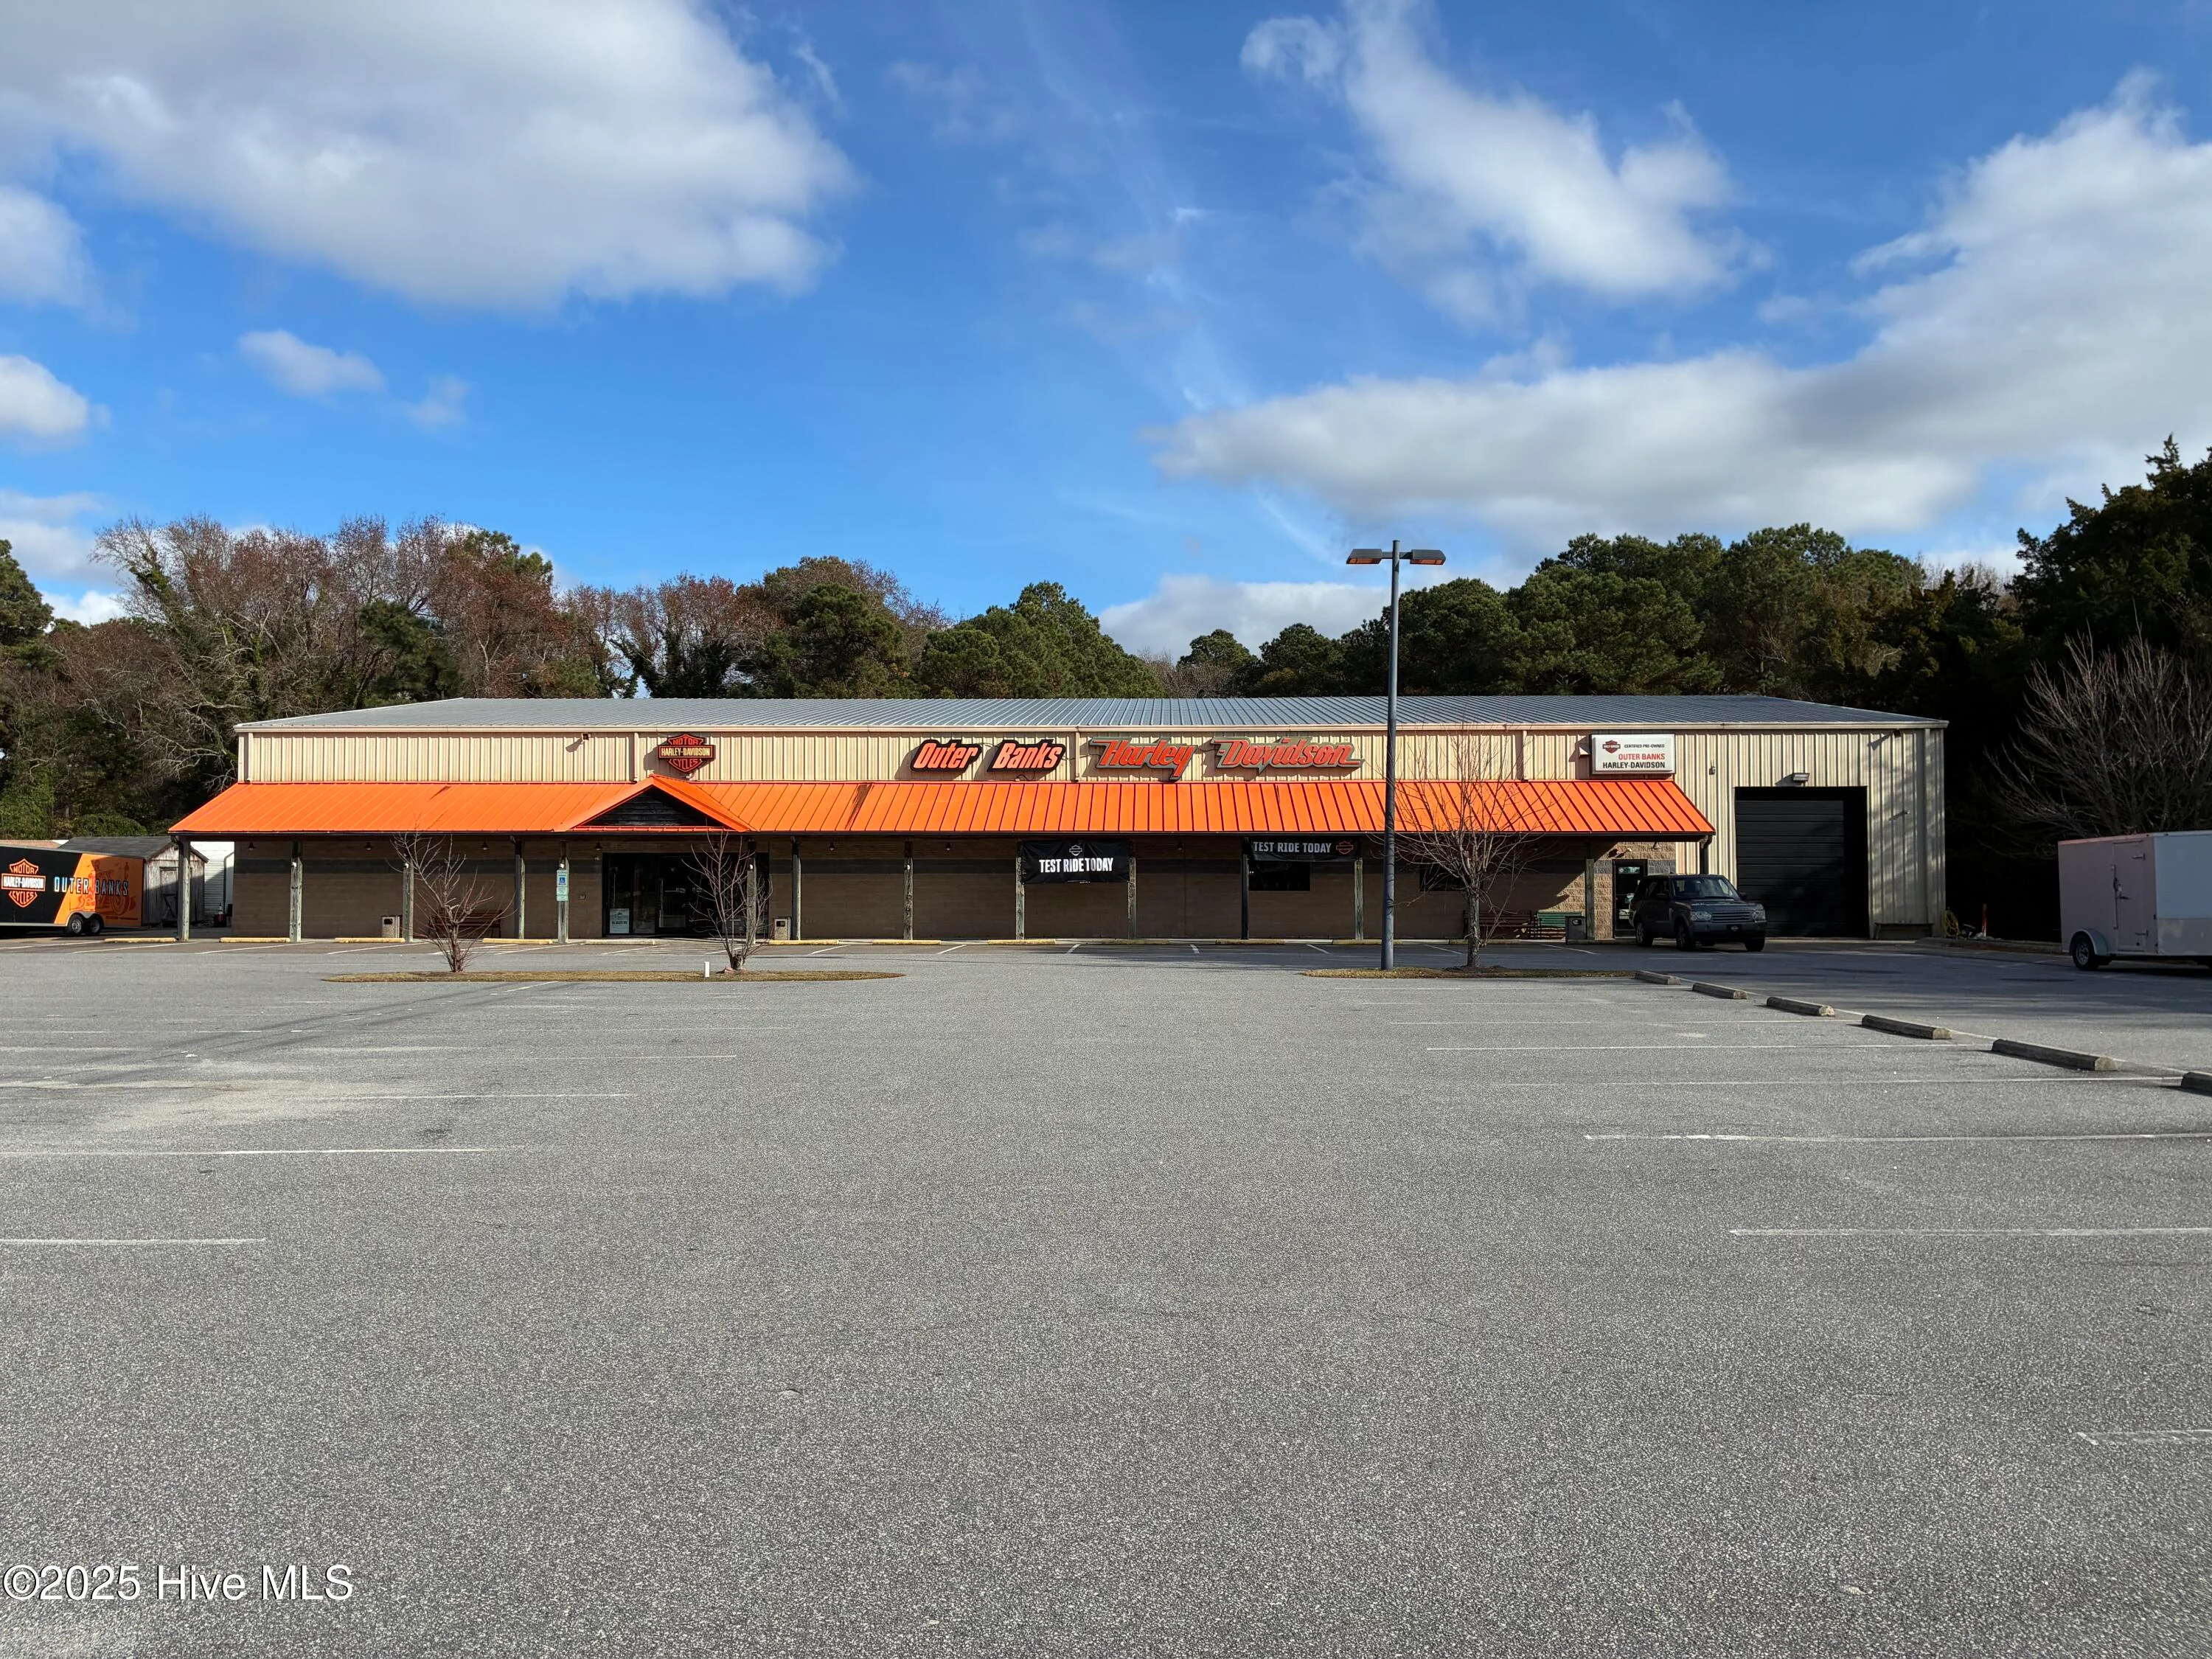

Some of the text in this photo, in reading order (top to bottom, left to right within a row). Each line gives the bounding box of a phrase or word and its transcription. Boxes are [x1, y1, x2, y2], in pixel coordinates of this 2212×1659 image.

[672, 736, 699, 745] MOTOR
[661, 747, 711, 757] HARLEY-DAVIDSON
[913, 742, 1062, 768] Outer Banks
[672, 758, 698, 770] CYCLES
[1094, 739, 1196, 780] Harley
[1253, 841, 1332, 853] TEST RIDE TODAY
[13, 862, 35, 874] MOTOR
[1039, 858, 1114, 873] TEST RIDE TODAY
[54, 876, 129, 896] OUTER BANKS
[13, 891, 34, 905] CYCLES
